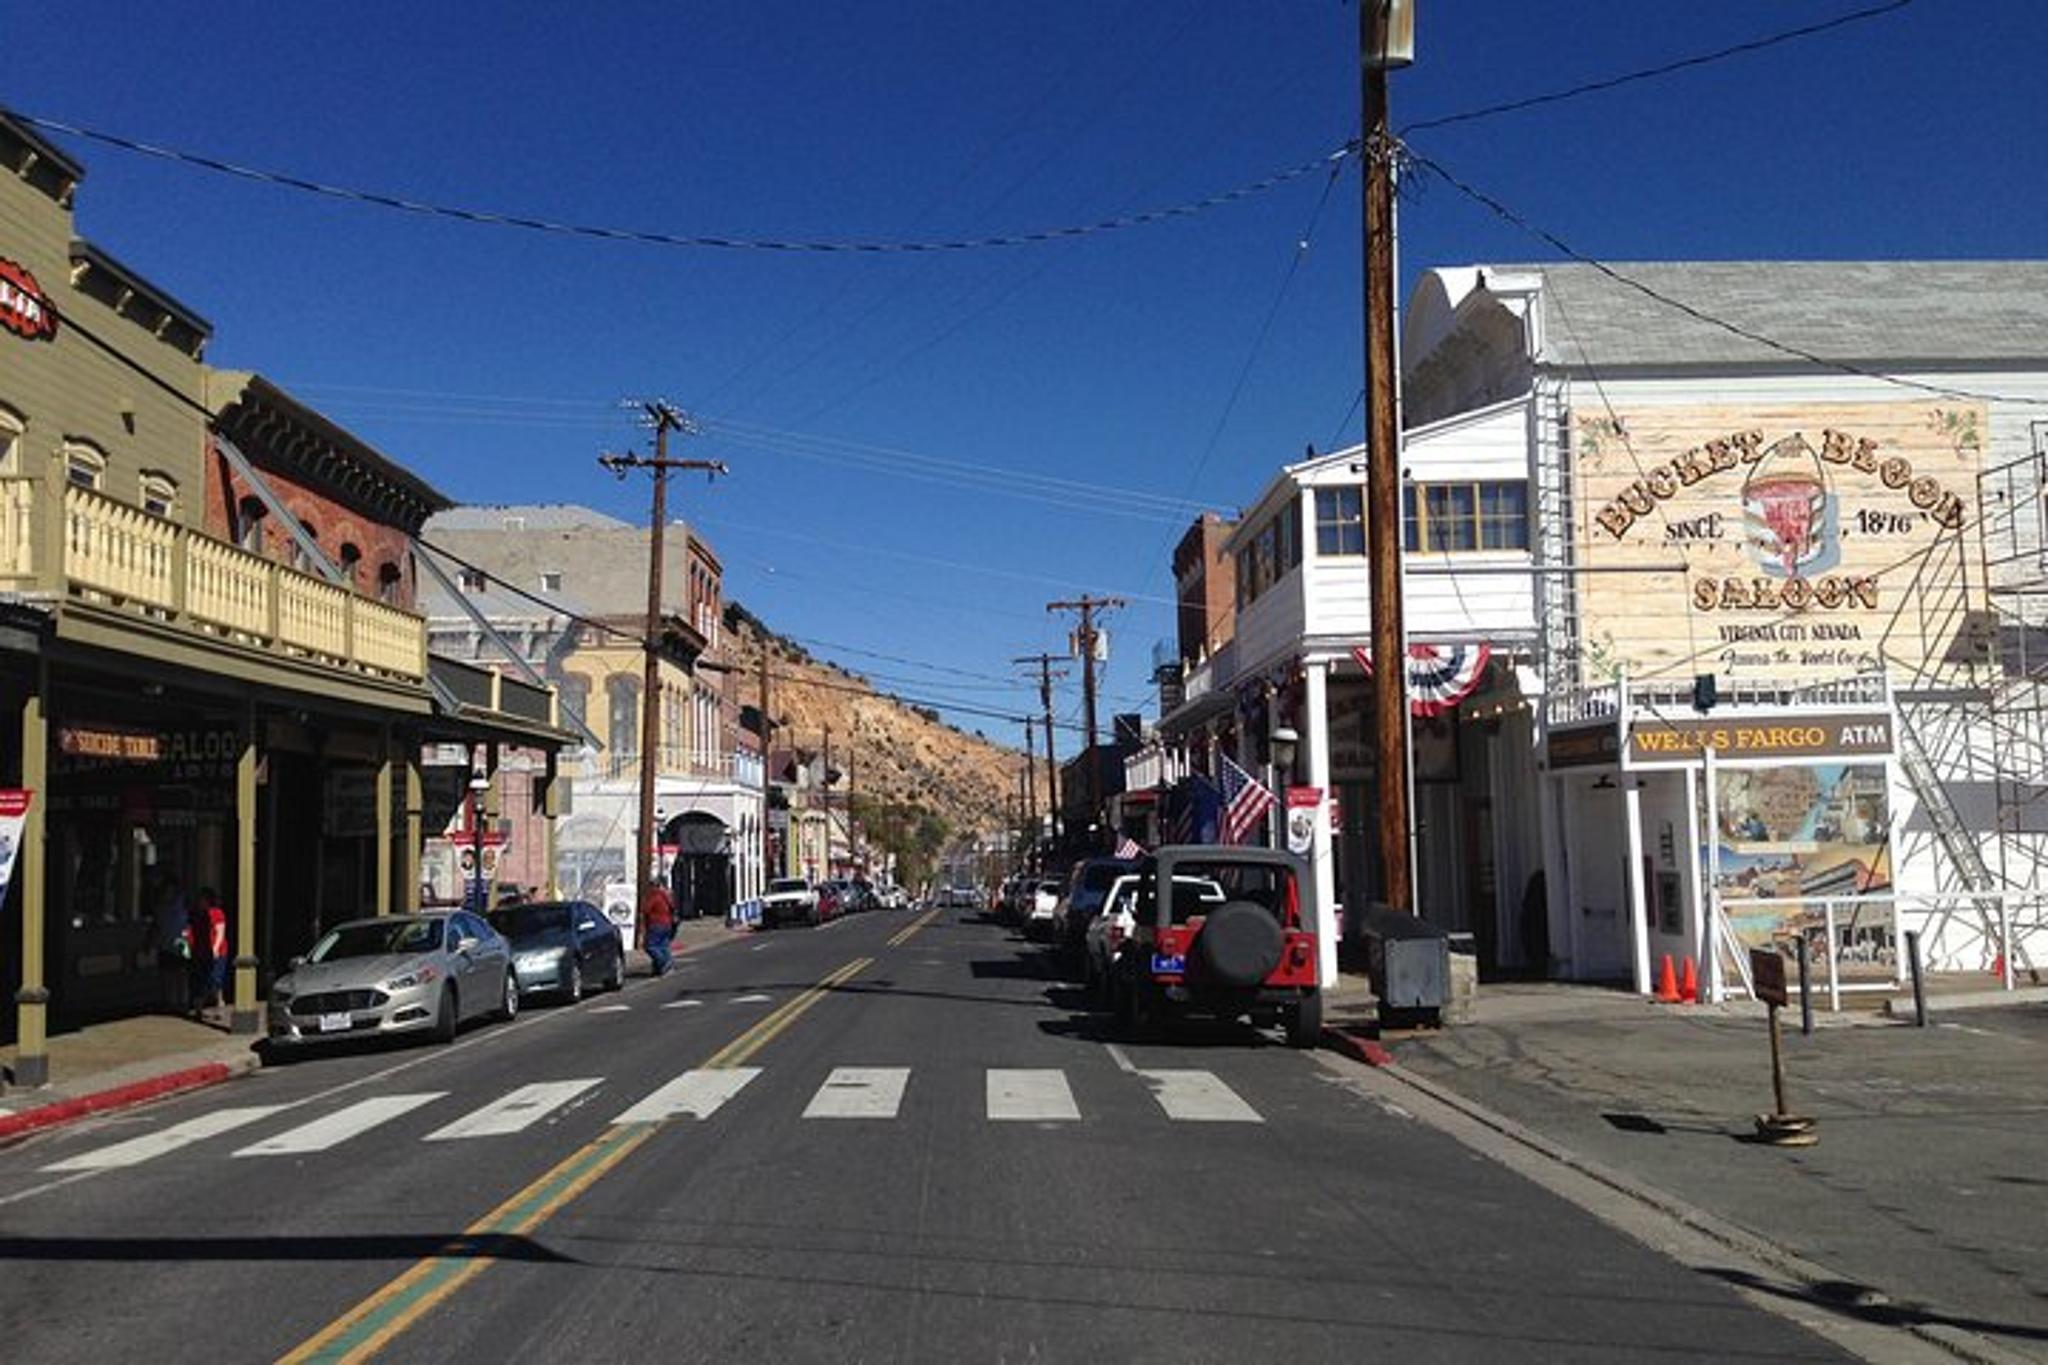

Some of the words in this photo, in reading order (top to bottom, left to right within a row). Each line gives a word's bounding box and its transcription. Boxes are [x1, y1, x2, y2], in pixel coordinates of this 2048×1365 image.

[1596, 428, 1763, 540] BUCKET
[1821, 428, 1964, 529] BLOOD
[1665, 511, 1723, 539] SINCE
[1694, 575, 1879, 611] SALOON
[1718, 624, 1777, 643] VIRGINIA
[1779, 624, 1807, 641] CITY
[1811, 624, 1862, 641] NEVADA
[1636, 730, 1729, 751] WELLS
[1735, 727, 1825, 749] FARGO
[1840, 724, 1887, 745] ATM
